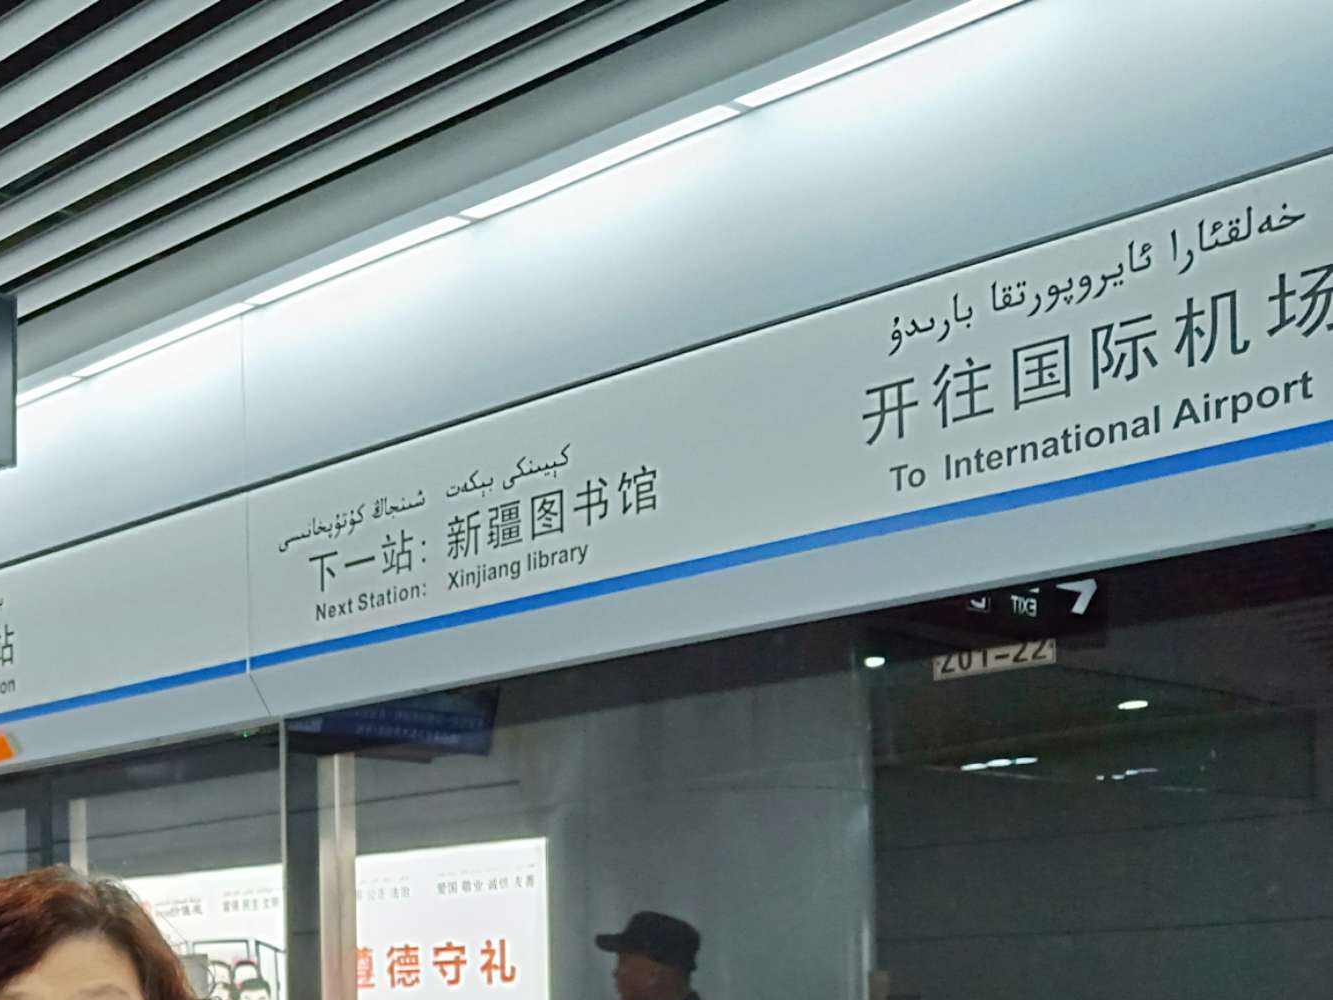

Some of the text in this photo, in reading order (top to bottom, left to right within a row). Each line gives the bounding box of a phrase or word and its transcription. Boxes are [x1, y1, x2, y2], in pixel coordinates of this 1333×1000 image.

[861, 262, 1333, 447] 开往国际机场
[889, 369, 1315, 493] To International Airport
[446, 465, 658, 563] 新疆图书馆
[315, 543, 589, 622] Next Station: Xinjiang library
